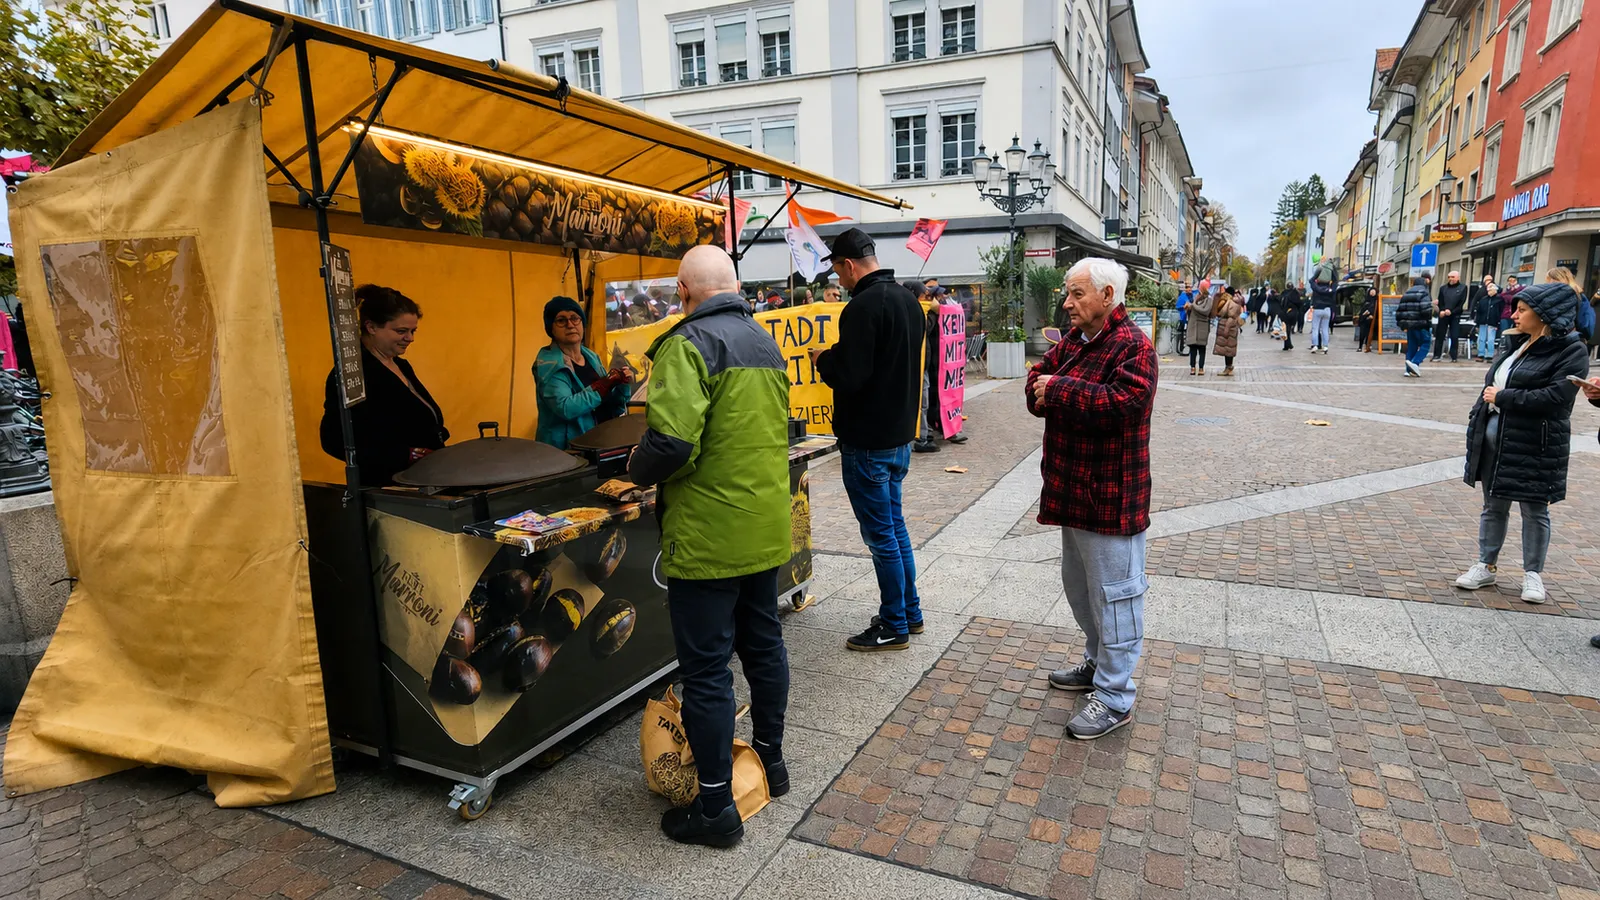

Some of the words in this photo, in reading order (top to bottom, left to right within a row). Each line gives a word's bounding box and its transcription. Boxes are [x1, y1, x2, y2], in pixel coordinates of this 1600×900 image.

[547, 190, 625, 242] Marroni
[1502, 190, 1530, 221] MANOR
[1531, 183, 1549, 211] BAR
[765, 315, 832, 348] TADT
[371, 553, 443, 626] Marroni
